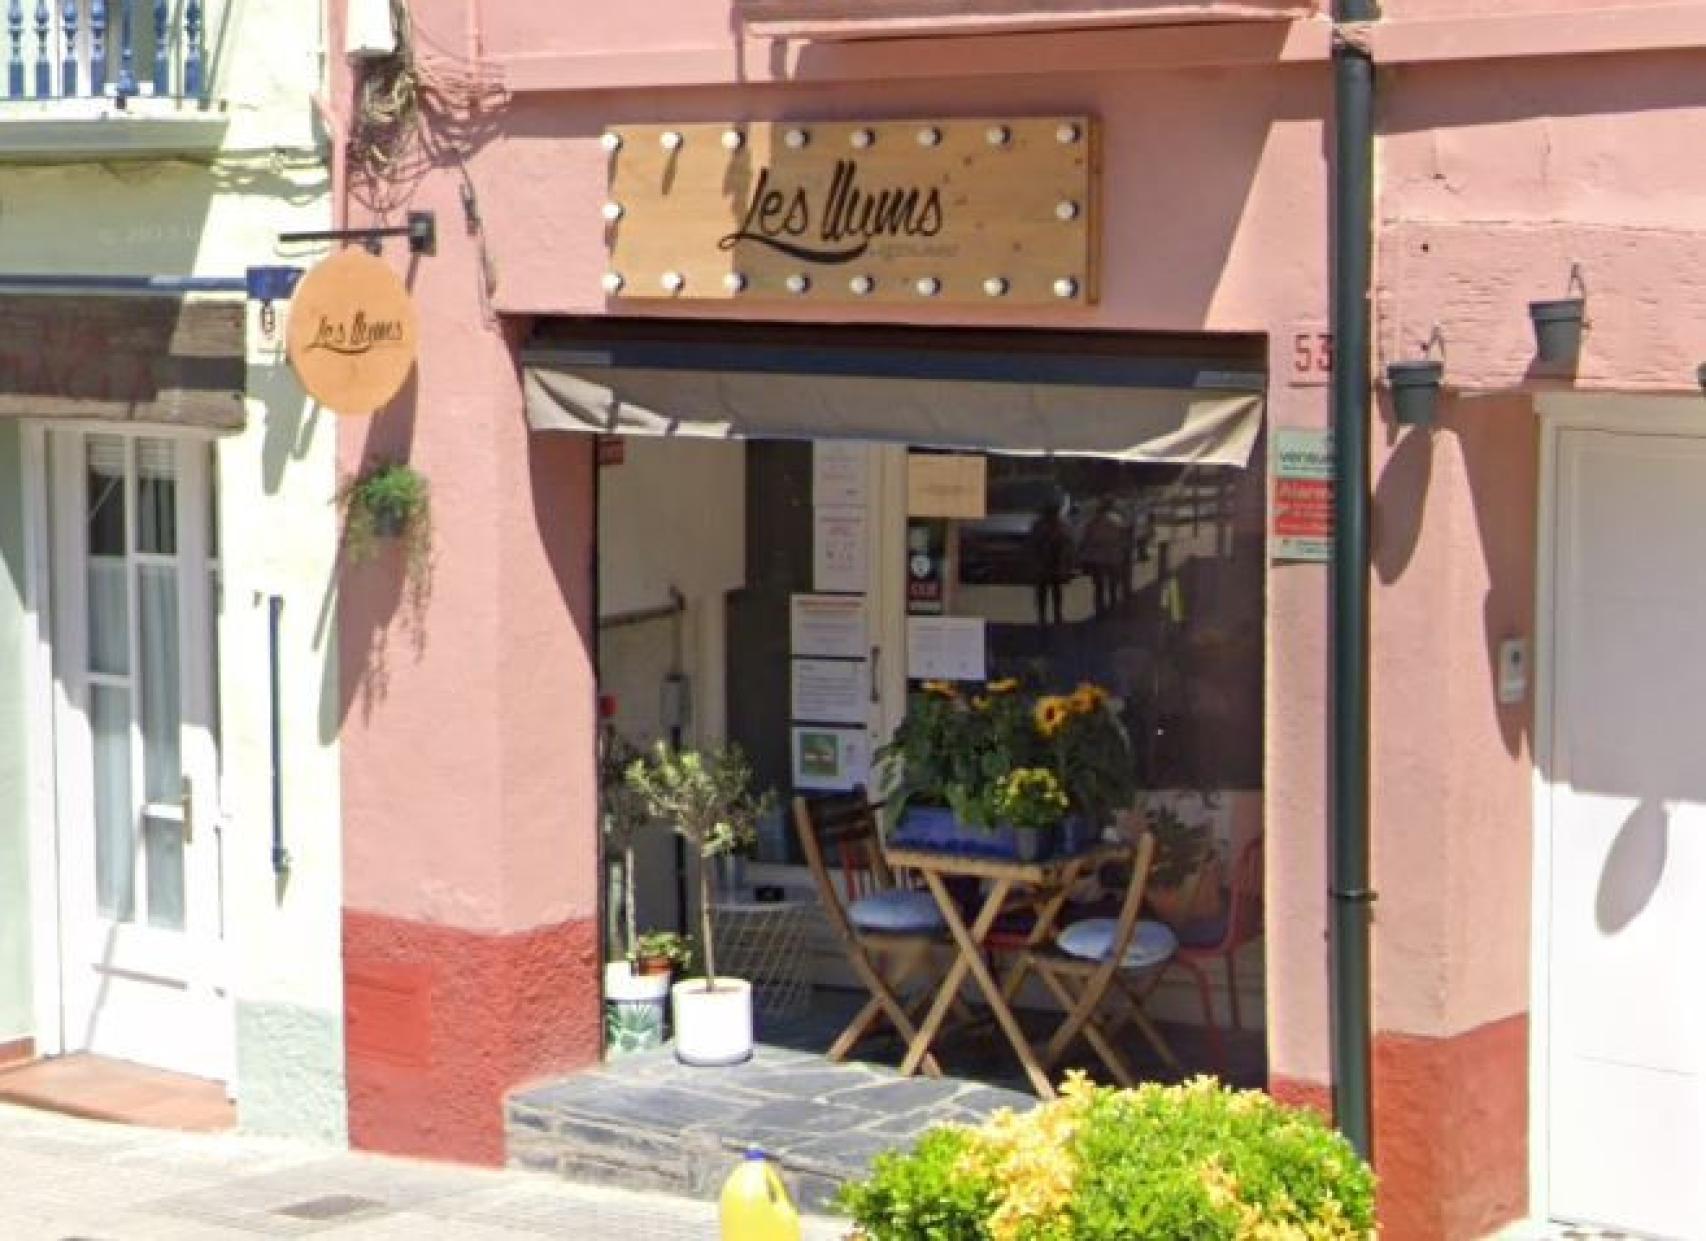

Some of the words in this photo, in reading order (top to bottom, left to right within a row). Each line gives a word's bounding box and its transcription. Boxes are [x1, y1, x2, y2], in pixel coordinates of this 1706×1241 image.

[718, 167, 810, 262] Les
[821, 160, 943, 241] llums
[1295, 333, 1333, 372] 53
